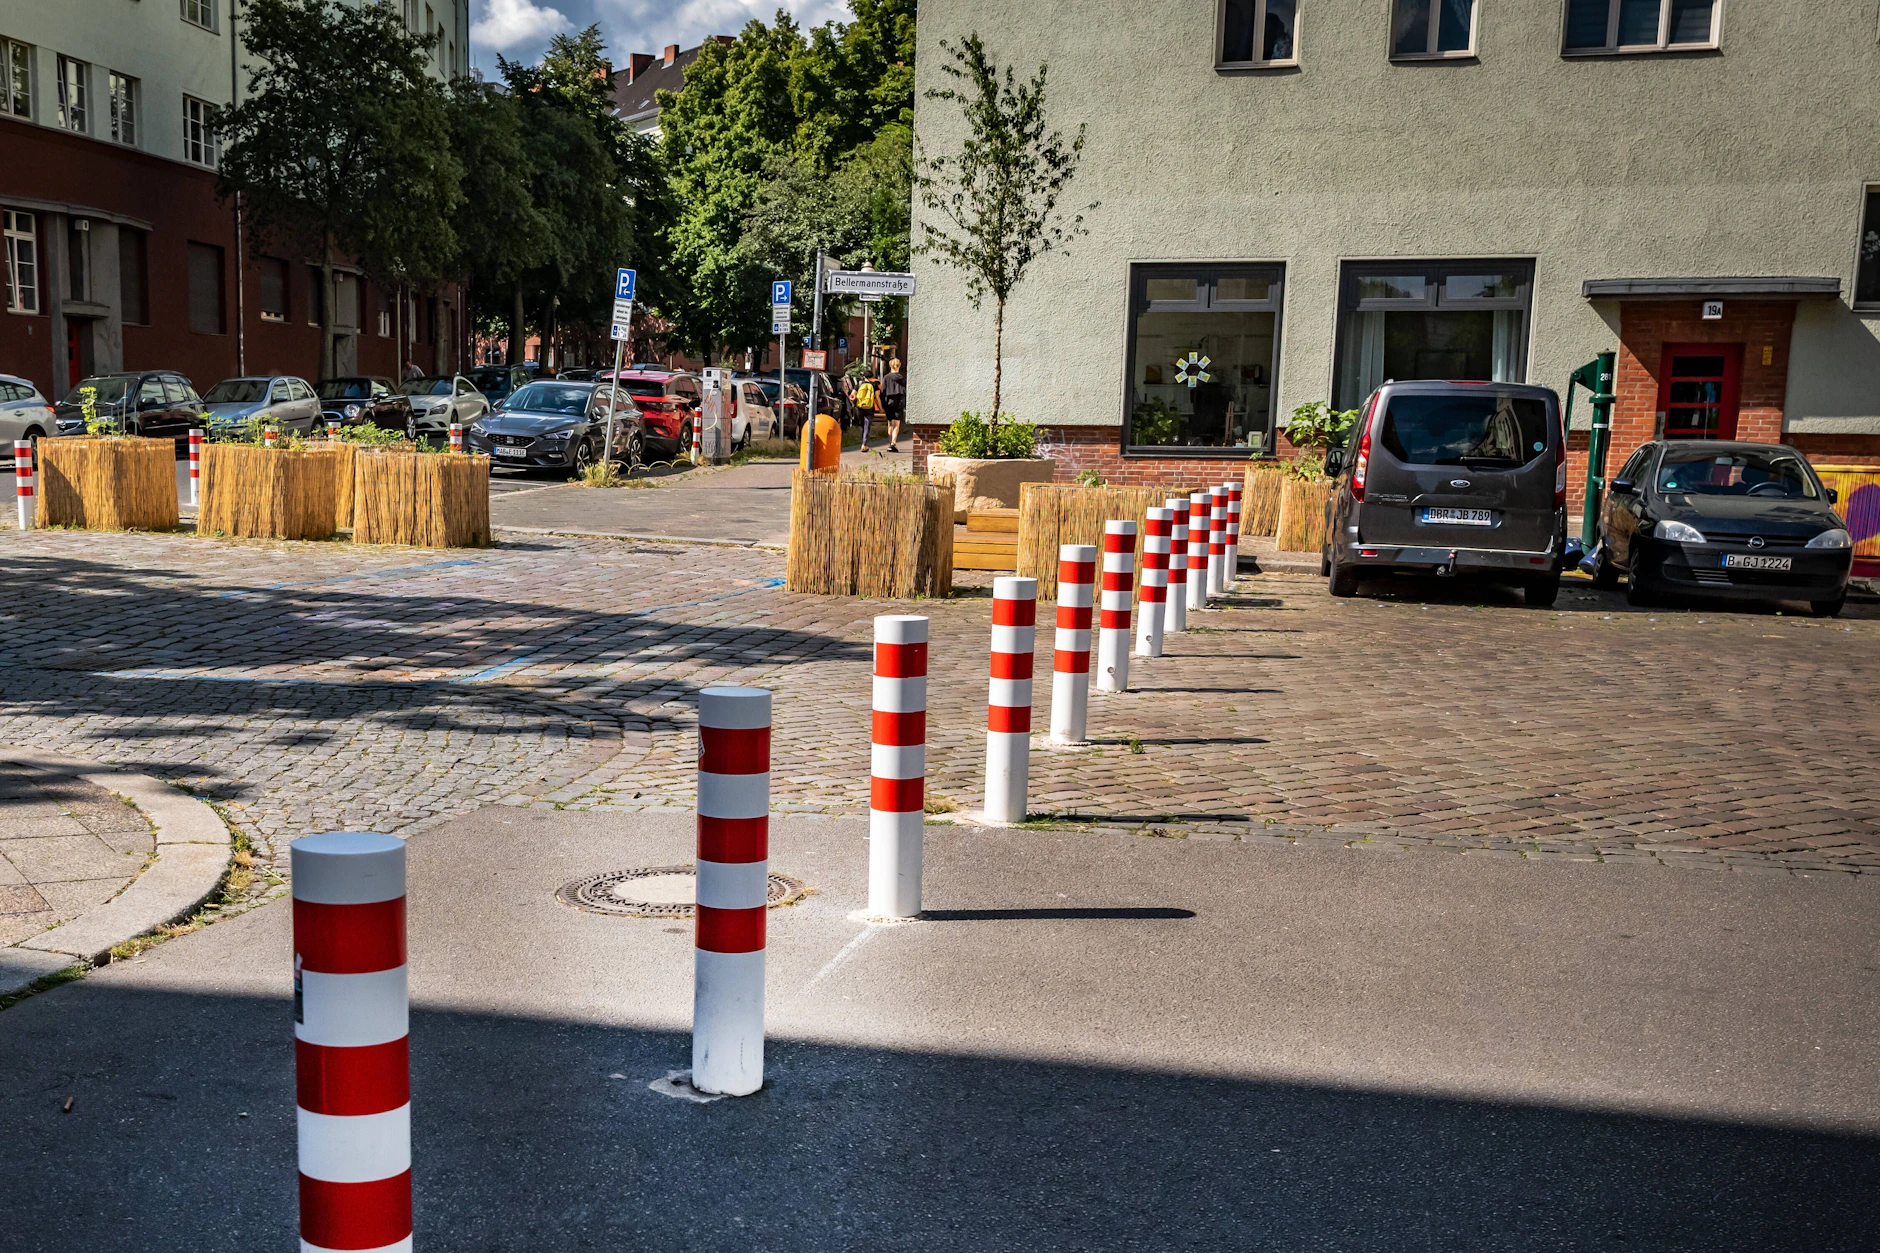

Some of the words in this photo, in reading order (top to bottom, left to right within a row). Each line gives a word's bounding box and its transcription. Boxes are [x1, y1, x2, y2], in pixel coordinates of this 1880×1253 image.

[619, 272, 630, 295] P
[835, 277, 908, 291] Bellermannstraße
[775, 284, 786, 302] P
[1707, 305, 1721, 316] 19A
[839, 338, 846, 347] P
[1430, 508, 1449, 520] DBR
[1456, 509, 1469, 520] JB
[1471, 510, 1490, 521] 789
[1728, 555, 1735, 566] B
[1743, 556, 1759, 567] GJ
[1760, 557, 1789, 569] 1224
